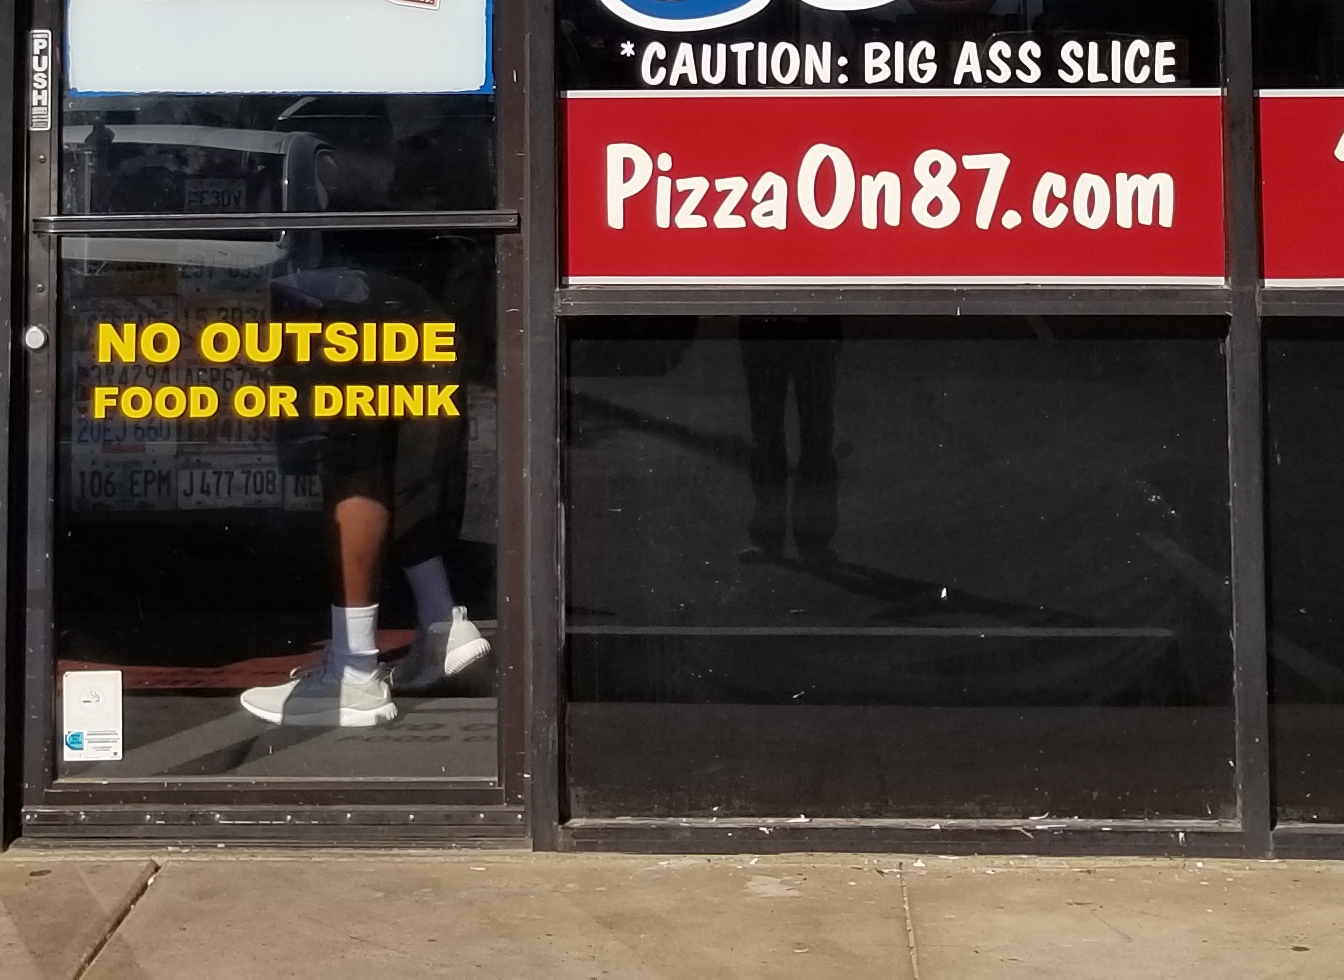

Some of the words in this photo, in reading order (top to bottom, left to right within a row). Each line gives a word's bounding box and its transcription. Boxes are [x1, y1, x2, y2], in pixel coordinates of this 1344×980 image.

[32, 39, 48, 106] PUSH
[863, 39, 938, 85] BIG
[953, 39, 1042, 85] ASS
[1058, 39, 1177, 84] SLICE
[605, 143, 1175, 232] PizzaOn87.com
[98, 323, 181, 363] NO
[199, 322, 457, 363] OUTSIDE
[94, 386, 218, 418] FOOD
[234, 386, 299, 418] OR
[314, 384, 460, 417] DRINK
